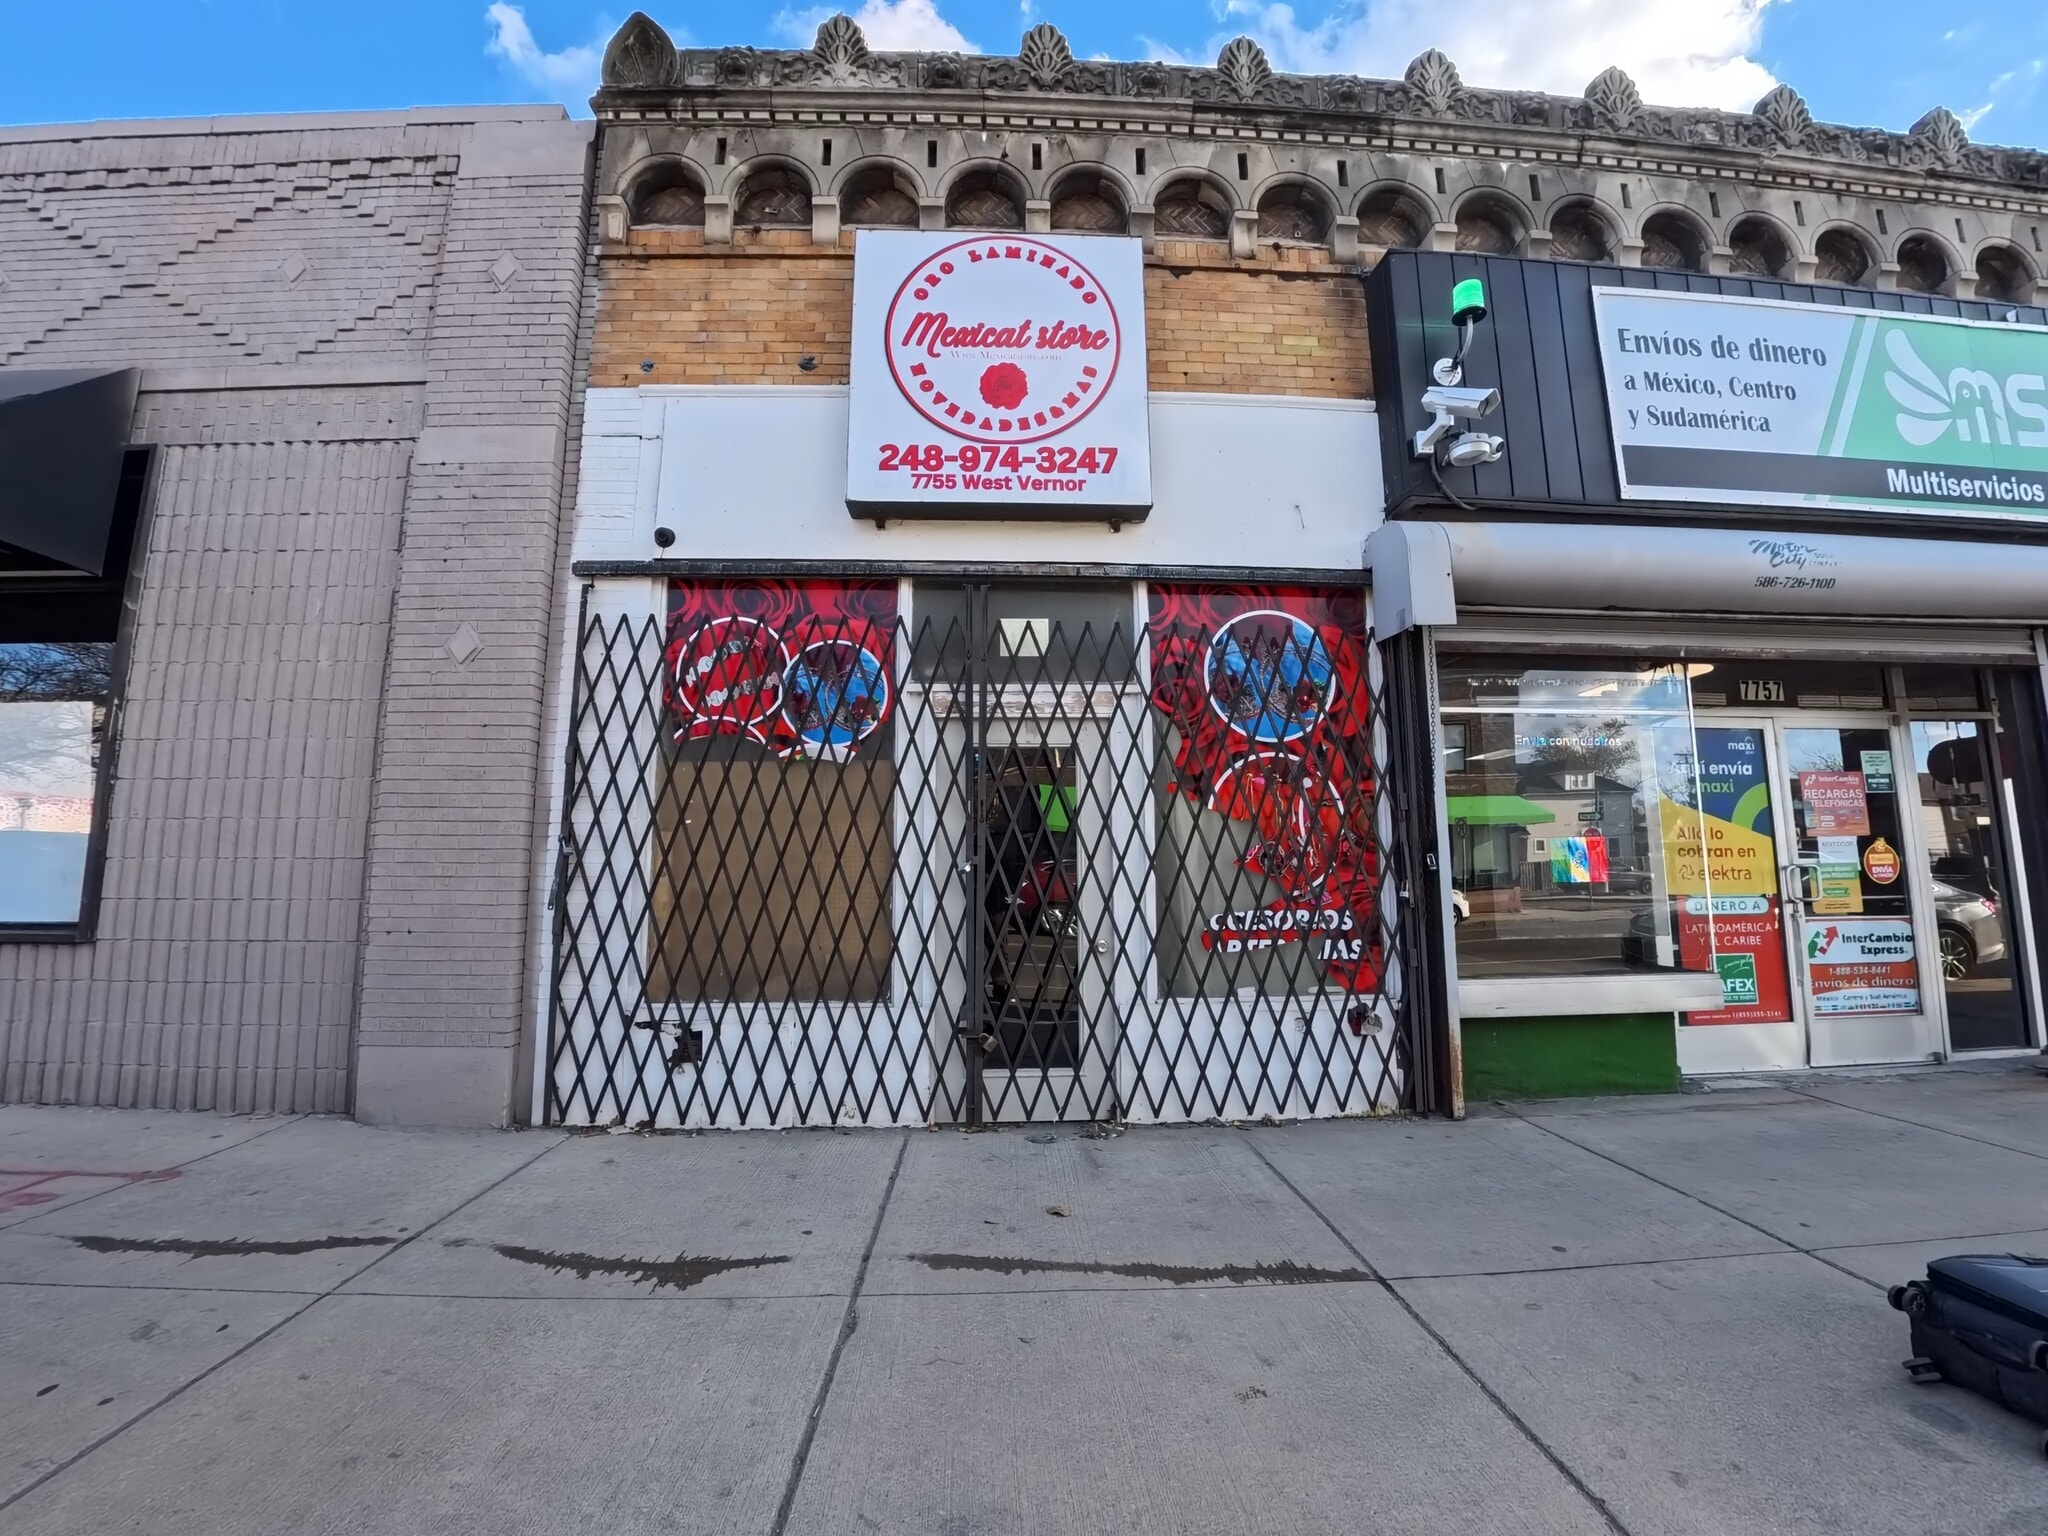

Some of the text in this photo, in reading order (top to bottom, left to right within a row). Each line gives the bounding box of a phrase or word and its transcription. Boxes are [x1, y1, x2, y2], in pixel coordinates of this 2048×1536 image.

[914, 246, 1097, 304] ORO LAMINADO
[902, 312, 1110, 358] Mexicat store
[1617, 328, 1827, 366] Envíos de dinero
[1624, 371, 1797, 400] a México, Centro
[1628, 405, 1771, 432] y Sudamérica
[879, 444, 1118, 473] 248-974-3247
[911, 474, 1086, 491] 7755 West Vernor
[1887, 468, 2045, 502] Multiservicios
[1748, 539, 1817, 554] Motor
[1770, 551, 1806, 570] City
[1754, 576, 1836, 589] 586-726-1100
[1741, 681, 1782, 700] 7757
[1728, 742, 1755, 750] maxi
[1669, 760, 1753, 779] Aqí envía
[1803, 789, 1863, 799] RECARGAS
[1710, 827, 1724, 840] lo
[1737, 847, 1756, 858] en
[1698, 864, 1752, 880] elektra
[1752, 901, 1761, 910] A
[1204, 909, 1354, 931] CCESOROS
[1699, 937, 1705, 945] Y
[1724, 936, 1761, 945] CARIBE
[1842, 932, 1913, 943] InterCambio
[1829, 966, 1891, 975] 1-888-534-8441
[1852, 977, 1868, 987] de
[1871, 977, 1914, 986] dinero
